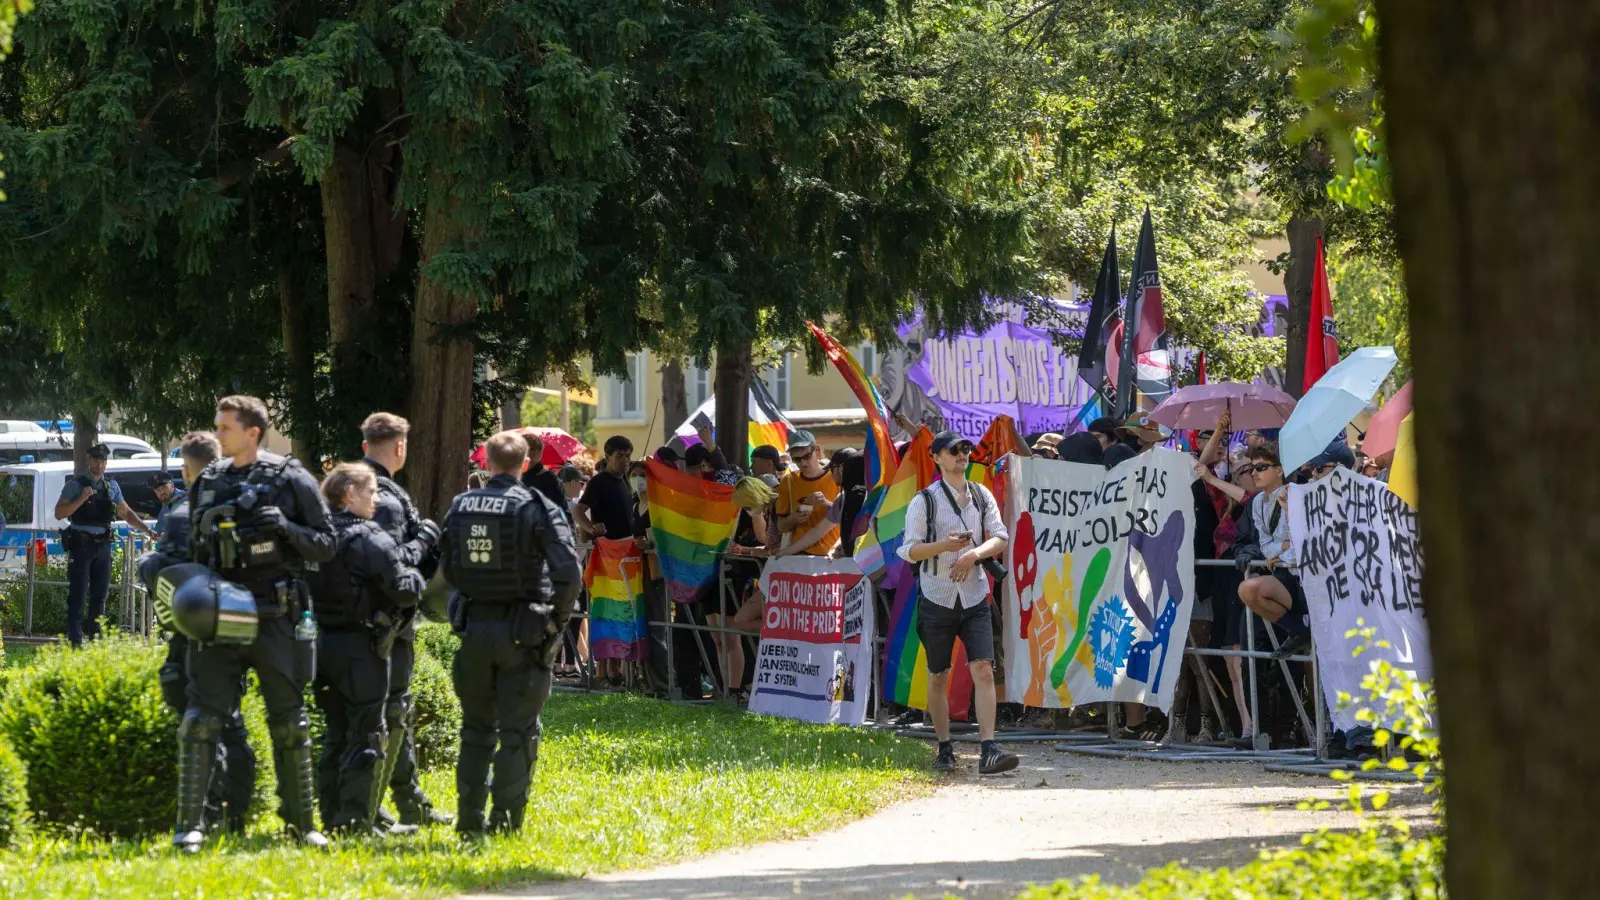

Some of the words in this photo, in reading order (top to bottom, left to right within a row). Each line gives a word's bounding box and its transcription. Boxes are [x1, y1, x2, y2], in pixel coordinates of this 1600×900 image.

[1028, 476, 1128, 517] RESISTNCE
[1135, 466, 1167, 498] HAS
[458, 496, 508, 514] POLIZEI
[470, 524, 488, 537] SN
[466, 538, 493, 551] 13/23
[1035, 527, 1081, 553] MAN
[766, 580, 789, 604] OIN
[792, 581, 813, 606] OUR
[815, 583, 845, 608] FIGHT
[766, 606, 790, 630] OIN
[792, 607, 809, 633] THE
[812, 610, 842, 633] PRIDE
[761, 644, 786, 657] UEER-
[757, 672, 771, 684] AT
